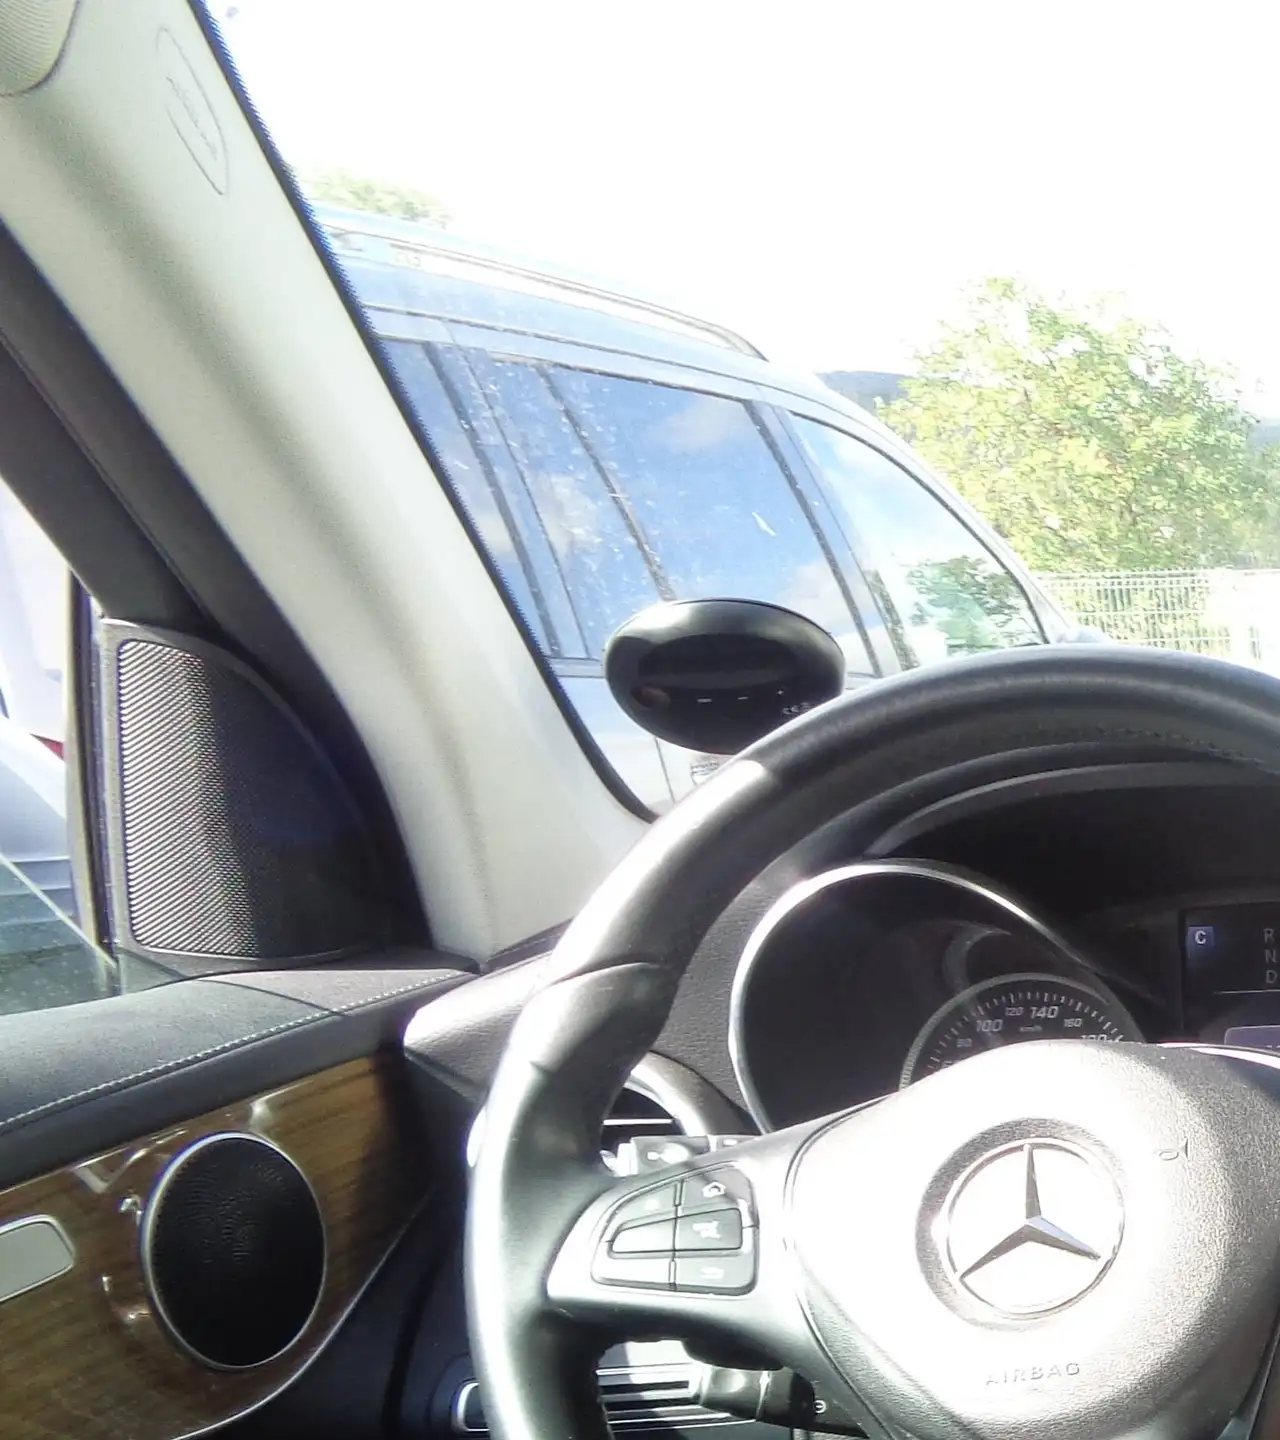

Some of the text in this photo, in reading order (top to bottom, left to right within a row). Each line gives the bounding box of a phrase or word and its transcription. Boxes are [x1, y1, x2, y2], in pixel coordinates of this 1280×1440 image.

[1194, 930, 1207, 945] C
[1264, 928, 1275, 943] R
[1266, 969, 1278, 984] D
[1030, 1006, 1059, 1019] 140
[976, 1019, 1004, 1033] 100
[985, 1362, 1080, 1386] AIRBAG
